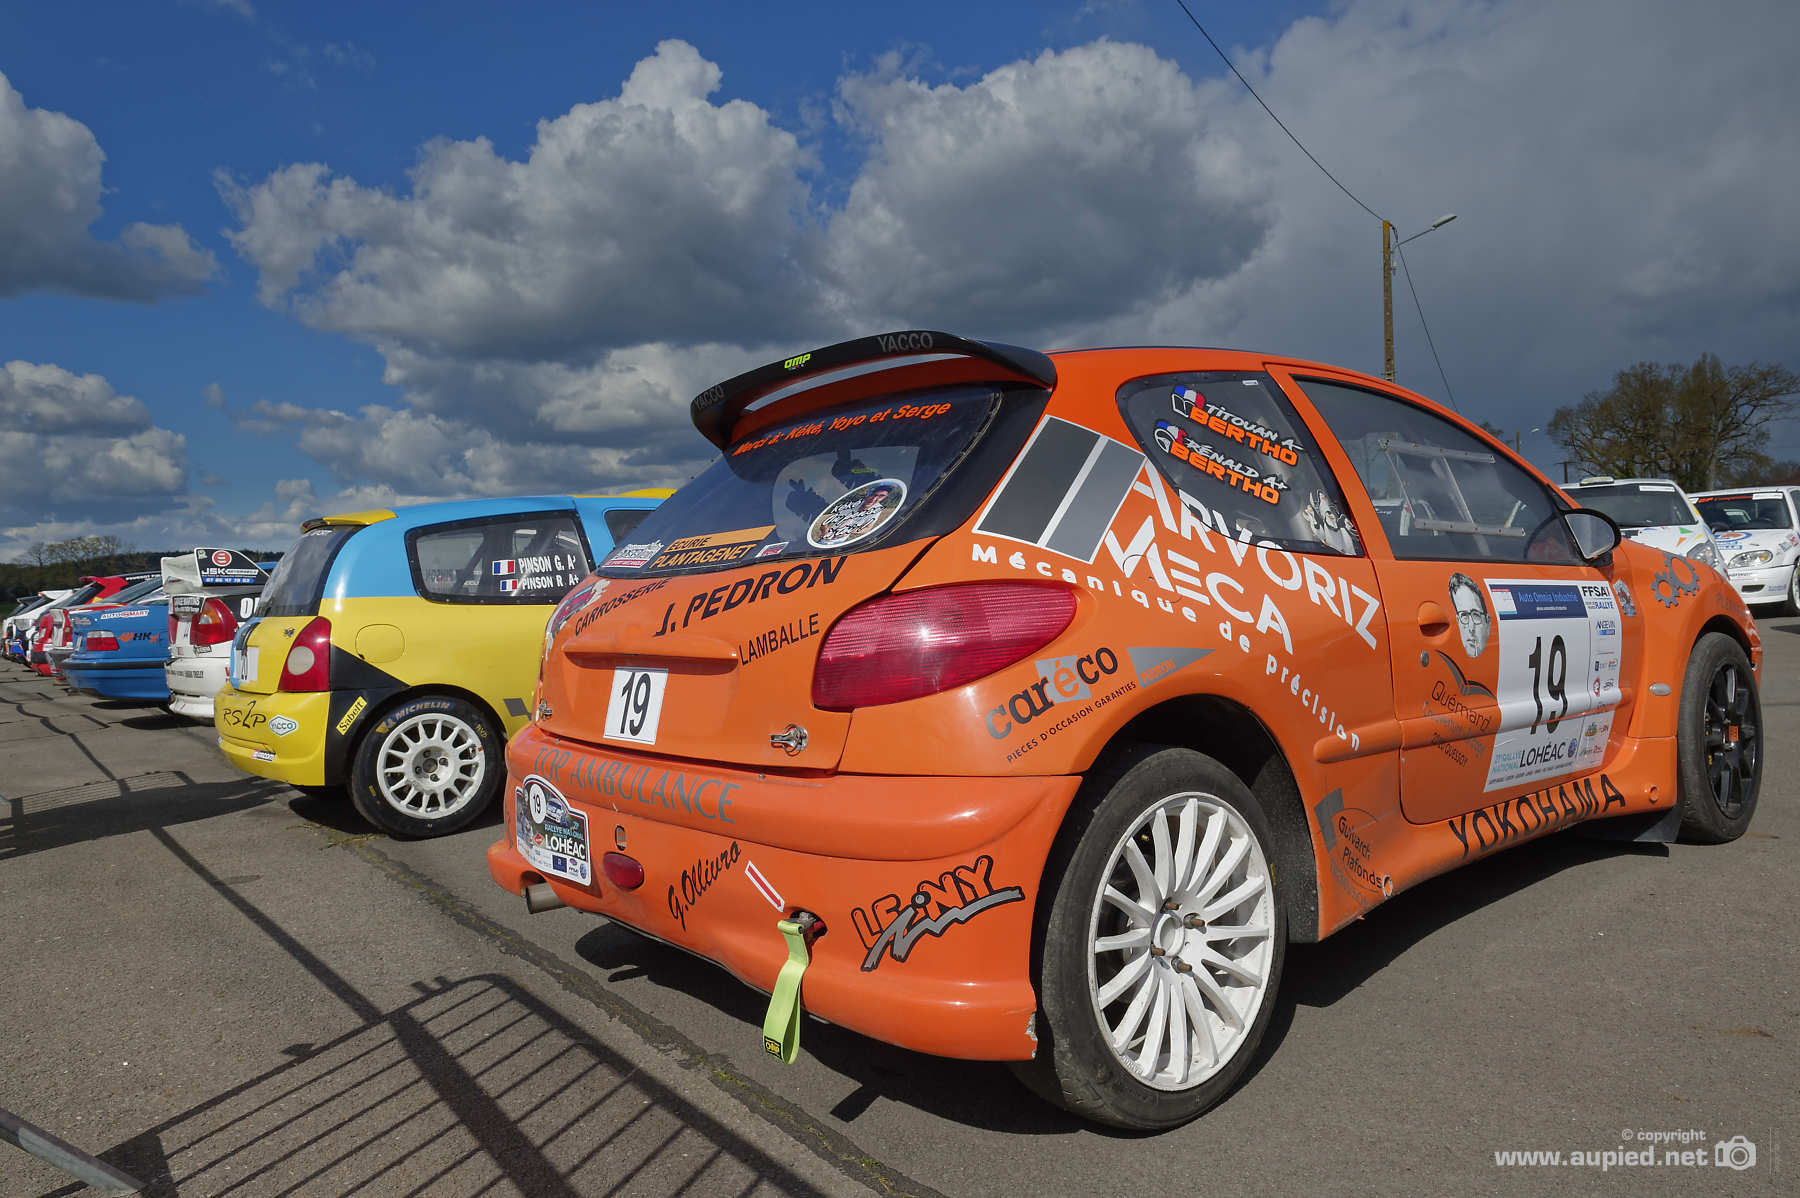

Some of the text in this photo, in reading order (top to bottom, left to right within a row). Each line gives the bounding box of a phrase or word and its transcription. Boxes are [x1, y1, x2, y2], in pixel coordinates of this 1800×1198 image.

[877, 332, 933, 353] YACCO
[694, 385, 725, 409] YACCO
[869, 408, 893, 423] et
[892, 402, 952, 420] Serge
[1189, 405, 1299, 466] BERTHO
[1169, 439, 1280, 505] BERTHO
[518, 556, 552, 573] PINSON
[649, 543, 757, 568] PLANTAGENET
[1132, 455, 1381, 651] ARVORIZ
[522, 576, 554, 590] PINSON
[575, 577, 673, 637] CARROSSERIE
[683, 556, 848, 628] PEDRON
[971, 543, 1197, 622] Mécanique
[1219, 621, 1251, 654] de
[1104, 514, 1294, 656] MECA
[739, 613, 819, 666] LAMBALLE
[396, 701, 451, 720] MICHELIN
[620, 672, 651, 736] 19
[985, 648, 1118, 739] caréco
[1040, 705, 1094, 741] D'OCCASION
[1095, 681, 1137, 708] GARANTIES
[1529, 635, 1568, 735] 19
[339, 701, 365, 731] Sabelt
[1519, 741, 1567, 767] LOHÉAC
[533, 794, 541, 813] 19
[534, 747, 742, 823] TOP AMBULANCE
[1448, 773, 1626, 859] YOKOHAMA
[544, 834, 586, 860] LOHÉAC
[1343, 846, 1383, 889] Plafonds
